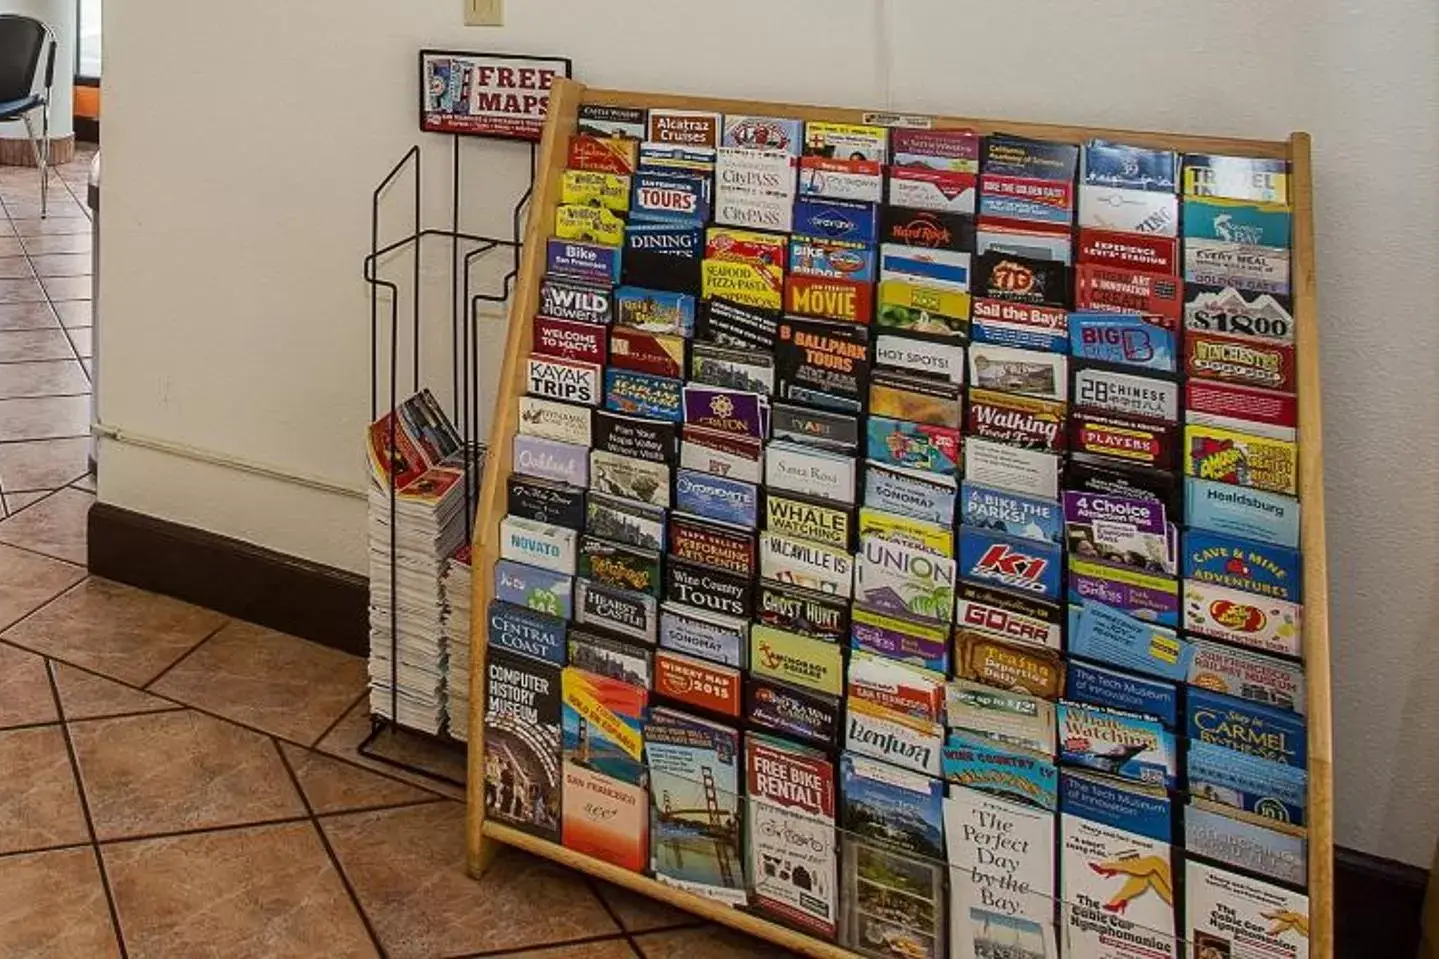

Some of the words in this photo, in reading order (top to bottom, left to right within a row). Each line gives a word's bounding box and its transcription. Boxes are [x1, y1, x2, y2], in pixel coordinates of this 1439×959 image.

[478, 66, 555, 90] FREE
[478, 92, 550, 115] MAPS
[657, 117, 709, 131] Alcatraz
[660, 131, 707, 142] Cruises
[721, 169, 779, 187] CityPASS
[641, 189, 692, 209] TOURS
[721, 206, 781, 226] CityPASS
[631, 233, 692, 248] DINING
[893, 225, 920, 238] Hard
[921, 226, 951, 243] Rock
[555, 256, 569, 264] San
[565, 246, 598, 262] Bike
[1095, 241, 1156, 256] EXPERIENCE
[1122, 251, 1167, 266] STADIUM
[1195, 250, 1232, 261] EVERY
[1236, 254, 1269, 267] MEAL
[552, 286, 609, 312] WILD
[793, 286, 857, 316] MOVIE
[974, 302, 1001, 317] Sail
[1003, 305, 1028, 321] the
[542, 327, 596, 343] WELCOME
[542, 336, 556, 347] TO
[559, 339, 598, 354] MACY'S
[794, 331, 868, 361] BALLPARK
[1081, 326, 1120, 345] BIG
[806, 350, 853, 373] TOURS
[878, 349, 904, 362] HOT
[906, 353, 949, 369] SPOTS!
[1194, 341, 1280, 368] WINCHESTER
[530, 361, 590, 387] KAYAK
[528, 377, 592, 401] TRIPS
[1109, 383, 1166, 403] CHINESE
[614, 425, 634, 435] Plan
[636, 427, 657, 439] Your
[972, 405, 1058, 437] Walking
[610, 433, 633, 446] Napa
[635, 437, 663, 451] Valley
[1086, 431, 1151, 451] PLAYERS
[876, 485, 934, 508] SONOMA?
[985, 493, 1018, 510] BIKE
[1023, 502, 1051, 518] THE
[1076, 497, 1088, 509] 4
[1093, 498, 1151, 518] Choice
[1207, 489, 1285, 517] Healdsburg
[769, 500, 845, 532] WHALE
[968, 502, 1026, 524] PARKS!
[680, 529, 704, 541] NAPA
[709, 535, 744, 549] VALLEY
[772, 516, 842, 542] WATCHING
[511, 533, 559, 558] NOVATO
[677, 538, 749, 564] PERFORMING
[770, 537, 829, 570] VACAVILLE
[834, 555, 847, 574] IS
[678, 548, 706, 564] ARTS
[707, 554, 749, 574] CENTER
[866, 541, 954, 587] UNION
[1192, 546, 1228, 564] CAVE
[1249, 551, 1287, 579] MINE
[673, 569, 700, 586] Wine
[701, 574, 744, 599] Country
[1194, 569, 1288, 598] ADVENTURES
[588, 591, 637, 615] HEARST
[674, 583, 744, 615] Tours
[763, 591, 802, 618] GHOST
[806, 602, 840, 628] HUNT
[596, 603, 644, 628] CASTLE
[492, 616, 559, 647] CENTRAL
[668, 630, 722, 652] SONOMA?
[501, 632, 548, 657] COAST
[661, 661, 704, 680] WINERY
[706, 671, 730, 686] MAP
[770, 651, 827, 675] ANCHORAGE
[783, 662, 822, 680] SQUARE
[1194, 656, 1240, 679] RAILWAY
[1244, 668, 1298, 693] MUSEUM
[1199, 648, 1222, 664] SAN
[1224, 654, 1293, 681] FRANCISCO
[489, 664, 549, 695] COMPUTER
[693, 680, 729, 699] 2015
[1075, 669, 1096, 683] The
[1098, 673, 1122, 689] Tech
[1124, 681, 1172, 702] Museum
[489, 679, 536, 706] HISTORY
[1075, 681, 1088, 691] of
[1088, 683, 1144, 705] Innovation
[488, 695, 538, 724] MUSEUM
[1066, 720, 1158, 752] Watching
[1194, 710, 1296, 756] CARMEL
[754, 756, 788, 780] FREE
[790, 764, 822, 788] BIKE
[566, 773, 585, 789] SAN
[586, 779, 636, 806] FRANCISCO
[757, 774, 822, 808] RENTAL!
[972, 808, 1014, 832] The
[962, 823, 1029, 854] Perfect
[977, 847, 1020, 873] Day
[971, 866, 997, 888] by
[1000, 873, 1030, 894] the
[980, 886, 1024, 916] Bay.
[1075, 893, 1101, 910] The
[1215, 902, 1236, 916] The
[1070, 904, 1107, 927] Cable
[1109, 914, 1135, 931] Car
[1210, 909, 1243, 928] Cable
[1244, 919, 1266, 932] Car
[1070, 915, 1171, 952] Nymphomaniac
[1209, 917, 1299, 952] Nymphomaniac
